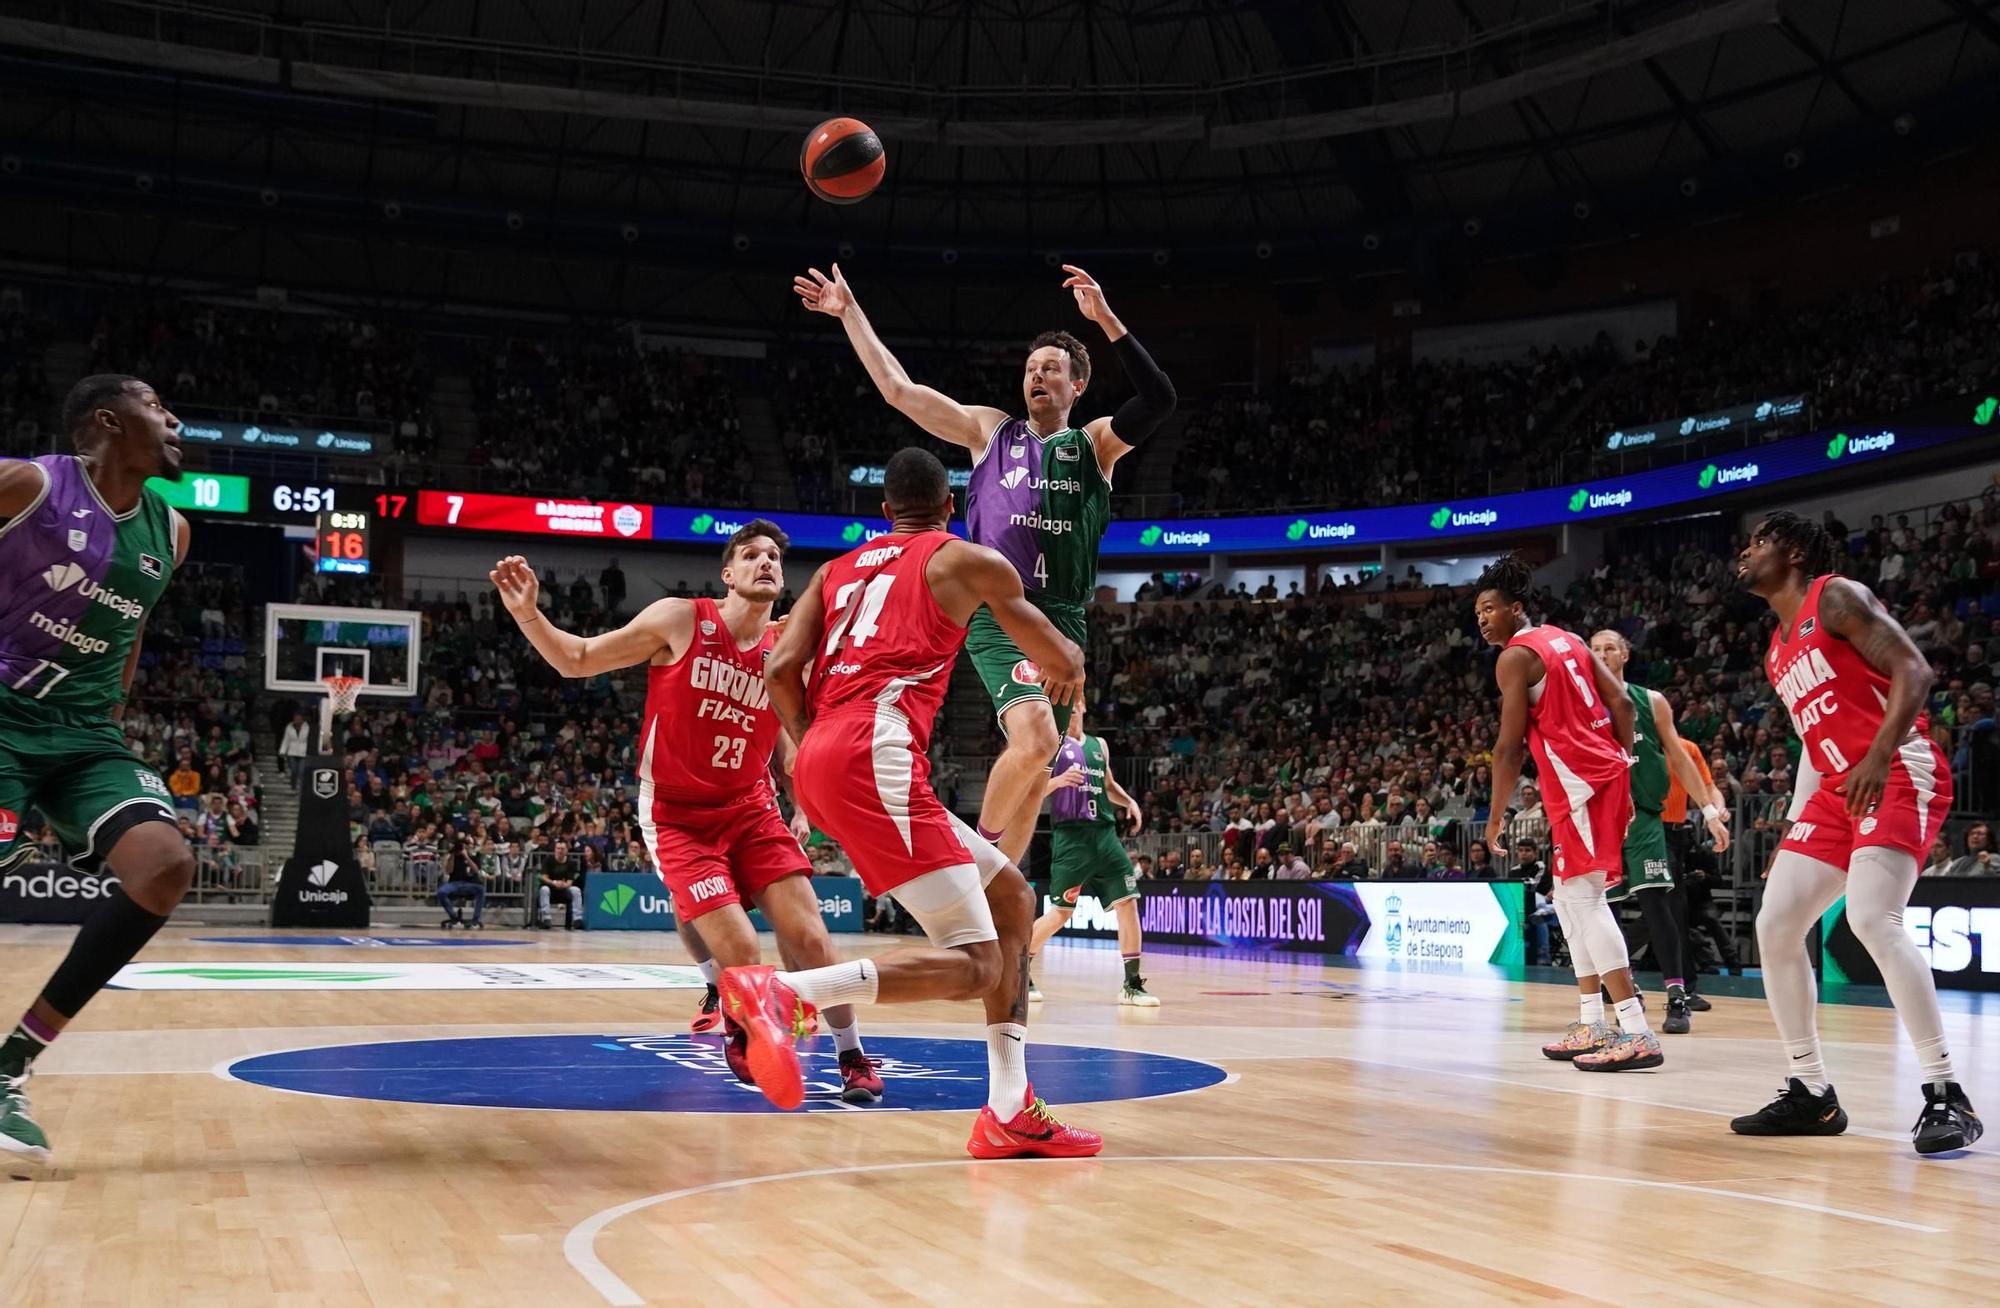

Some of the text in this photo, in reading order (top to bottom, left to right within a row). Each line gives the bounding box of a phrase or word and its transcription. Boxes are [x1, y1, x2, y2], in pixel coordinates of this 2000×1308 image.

[184, 427, 223, 440] Unicaja
[260, 432, 299, 446] Unicaja
[334, 437, 372, 452] Unicaja
[1622, 431, 1656, 446] Unicaja
[1848, 431, 1895, 454] Unicaja
[1718, 462, 1759, 483] Unicaja
[193, 478, 221, 507] 10
[1027, 476, 1081, 495] Uncaja
[273, 485, 335, 513] 6:51
[376, 494, 407, 519] 17
[447, 496, 464, 524] 7
[1589, 489, 1632, 508] Unicaja
[1009, 511, 1073, 535] málaga
[1452, 509, 1498, 527] Unicaja
[1163, 531, 1211, 548] Unicaja
[1309, 522, 1356, 541] Unicaja
[326, 532, 364, 560] 16
[1033, 553, 1049, 588] 4
[78, 577, 144, 620] Unicaja
[826, 573, 897, 657] 24
[29, 611, 110, 654] málaga
[12, 659, 70, 699] 77
[690, 656, 770, 711] GIRONA
[1563, 658, 1595, 708] 5
[1795, 690, 1839, 735] IATC
[711, 735, 747, 770] 23
[1820, 738, 1849, 773] 0
[1088, 799, 1098, 818] 9
[1786, 821, 1817, 843] SOY
[2, 870, 122, 899] ndes
[688, 876, 728, 904] YOSOY
[299, 889, 348, 905] Unicaja
[818, 894, 853, 917] caja
[1142, 888, 1186, 935] JARDÍN
[1188, 896, 1205, 936] DE
[1206, 896, 1221, 936] LA
[1224, 896, 1265, 938] COSTA
[1270, 897, 1294, 941] DEL
[1297, 897, 1325, 942] SOL
[1407, 915, 1470, 935] Ayuntamiento
[1407, 939, 1464, 958] de Estepona
